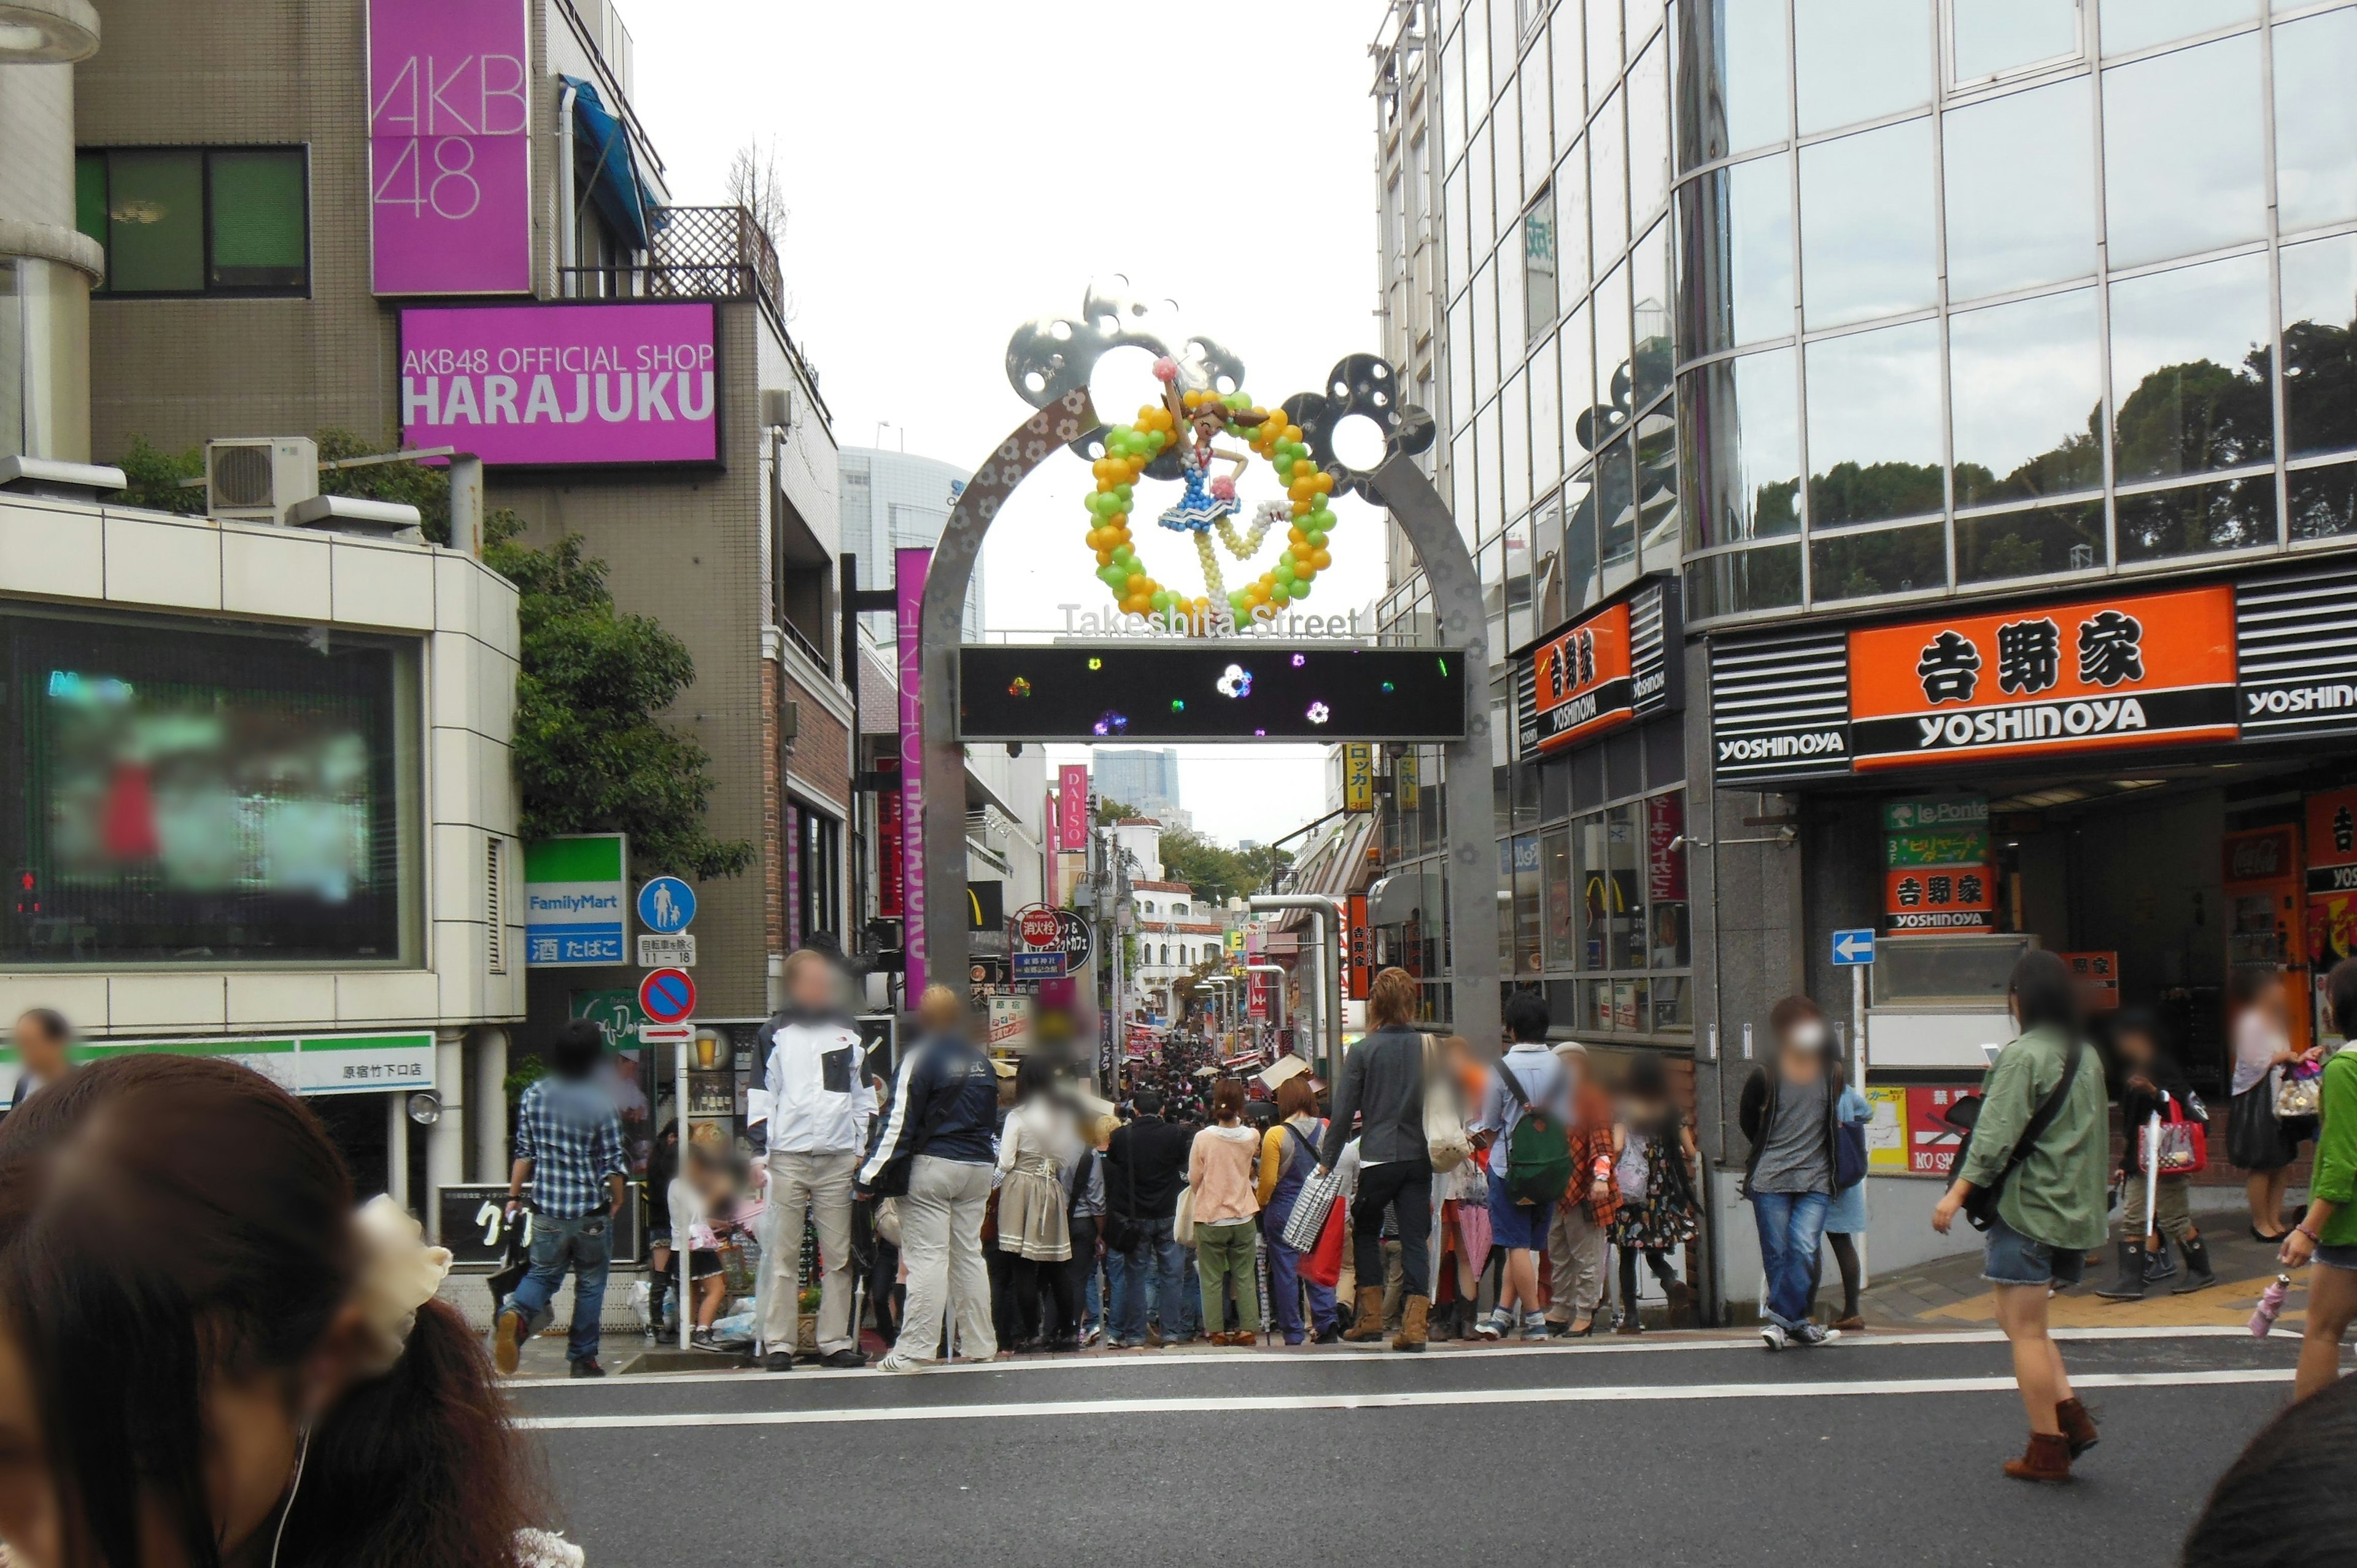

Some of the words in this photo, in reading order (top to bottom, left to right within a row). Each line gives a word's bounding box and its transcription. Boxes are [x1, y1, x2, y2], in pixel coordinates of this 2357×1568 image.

[371, 54, 527, 135] AKB
[373, 136, 481, 220] 48
[403, 347, 489, 375] AKB48
[498, 346, 627, 373] OFFICIAL
[637, 344, 714, 370] SHOP
[402, 371, 714, 426] HARAJUKU
[1058, 604, 1236, 638] Takeshita
[1251, 605, 1362, 638] Street
[1550, 627, 1595, 700] 吉野家
[1916, 609, 2145, 705] 吉野家
[1553, 693, 1596, 732] YOSHINOYA
[2248, 684, 2357, 716] YOSHIN
[1919, 698, 2147, 747] YOSHINOYA
[1720, 732, 1844, 761] YOSHINOYA
[1350, 743, 1369, 799] ロッカー
[1068, 773, 1080, 841] DAISO
[530, 895, 617, 913] FamilyMart
[1897, 874, 1983, 907] 吉野家
[1023, 921, 1055, 935] 消火栓
[1897, 913, 1983, 927] YOSHINOYA
[532, 939, 559, 961] 酒
[566, 940, 617, 957] たばこ
[641, 939, 693, 951] 自転車を除く
[645, 952, 657, 964] 11
[679, 952, 691, 963] 18
[1353, 927, 1365, 967] 吉野家
[2071, 957, 2110, 976] 野家
[343, 1063, 422, 1079] 原宿竹下口店
[1915, 1151, 1933, 1169] NO
